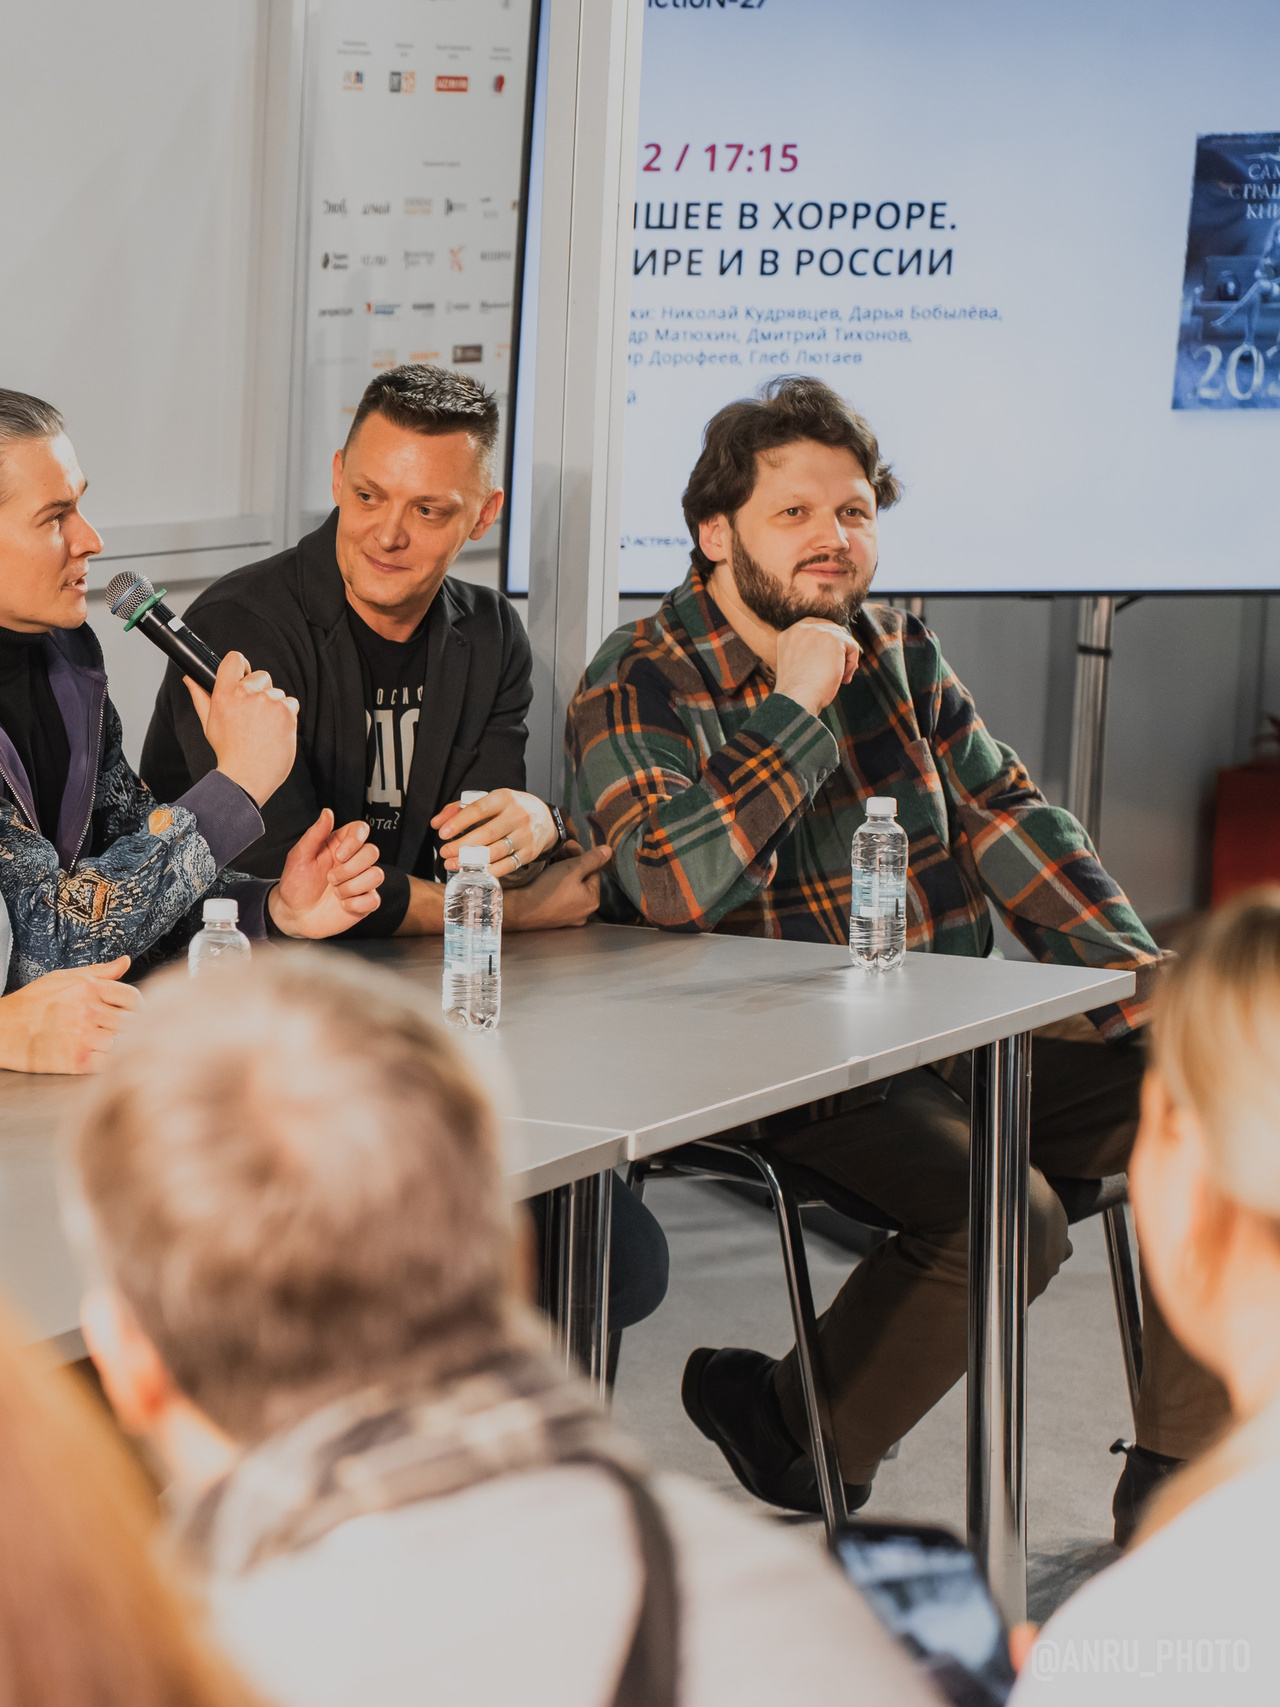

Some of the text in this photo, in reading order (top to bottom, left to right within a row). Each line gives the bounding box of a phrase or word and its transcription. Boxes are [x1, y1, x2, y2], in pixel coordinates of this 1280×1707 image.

[675, 144, 690, 172] /
[704, 144, 799, 173] 17:15
[633, 202, 958, 230] ШЕЕ В ХОРРОРЕ.
[633, 248, 954, 276] ИРЕ И В РОССИИ
[661, 306, 738, 320] Николай
[745, 306, 842, 323] Кудрявцев,
[849, 305, 904, 322] Дарья
[910, 304, 1002, 321] Бобылёва,
[655, 328, 741, 343] Матюхин,
[746, 328, 827, 344] Дмитрий
[834, 328, 912, 343] Тихонов,
[649, 350, 742, 367] Дорофеев,
[749, 350, 790, 364] Глеб
[796, 350, 863, 364] Лютаев
